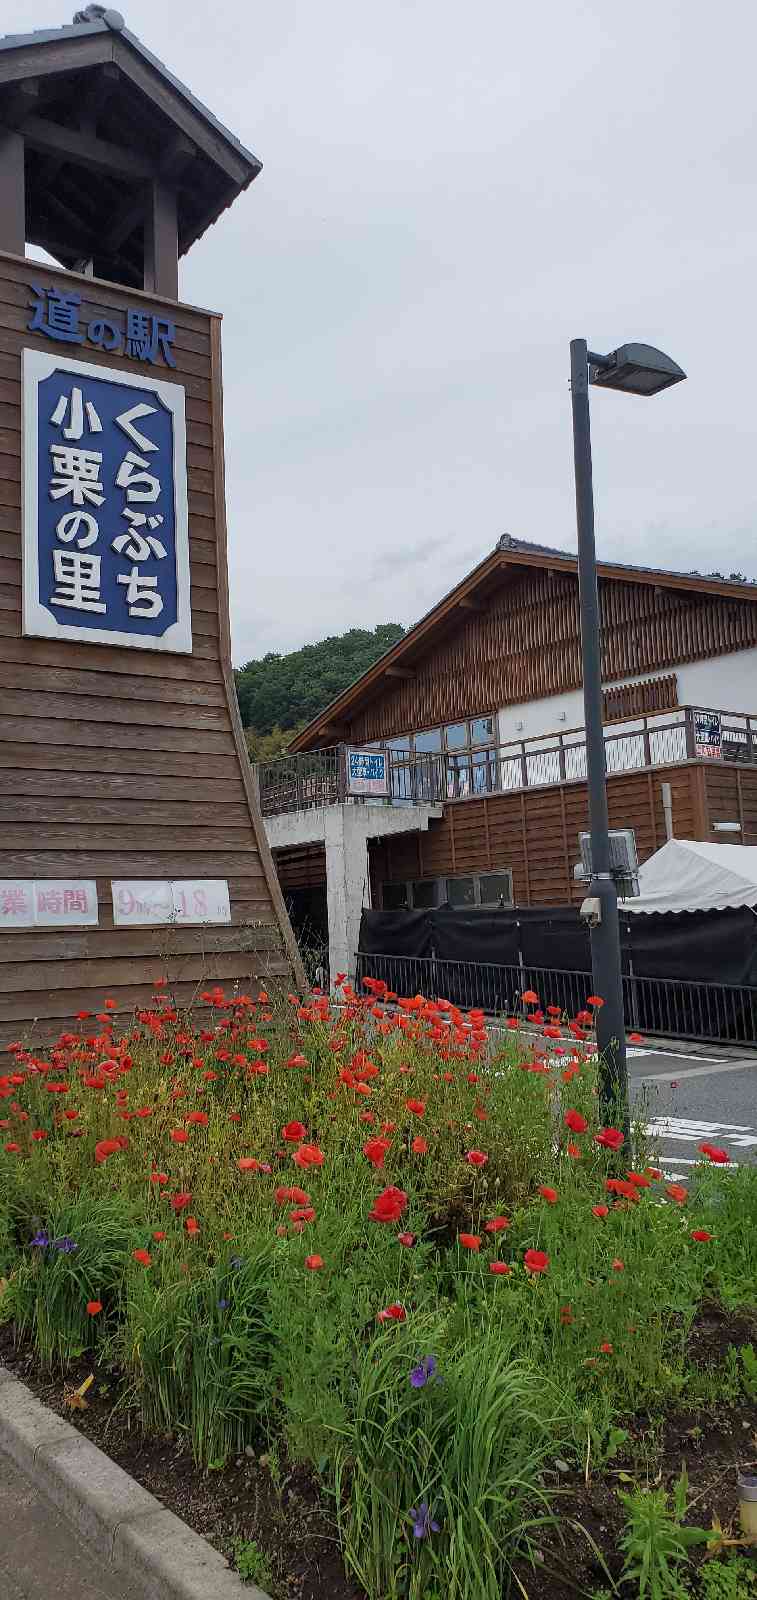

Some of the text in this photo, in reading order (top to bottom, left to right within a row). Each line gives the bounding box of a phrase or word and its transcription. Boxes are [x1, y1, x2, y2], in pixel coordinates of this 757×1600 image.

[27, 283, 177, 368] 道の駅
[49, 386, 107, 615] 小栗の里
[112, 402, 168, 619] くらぶち
